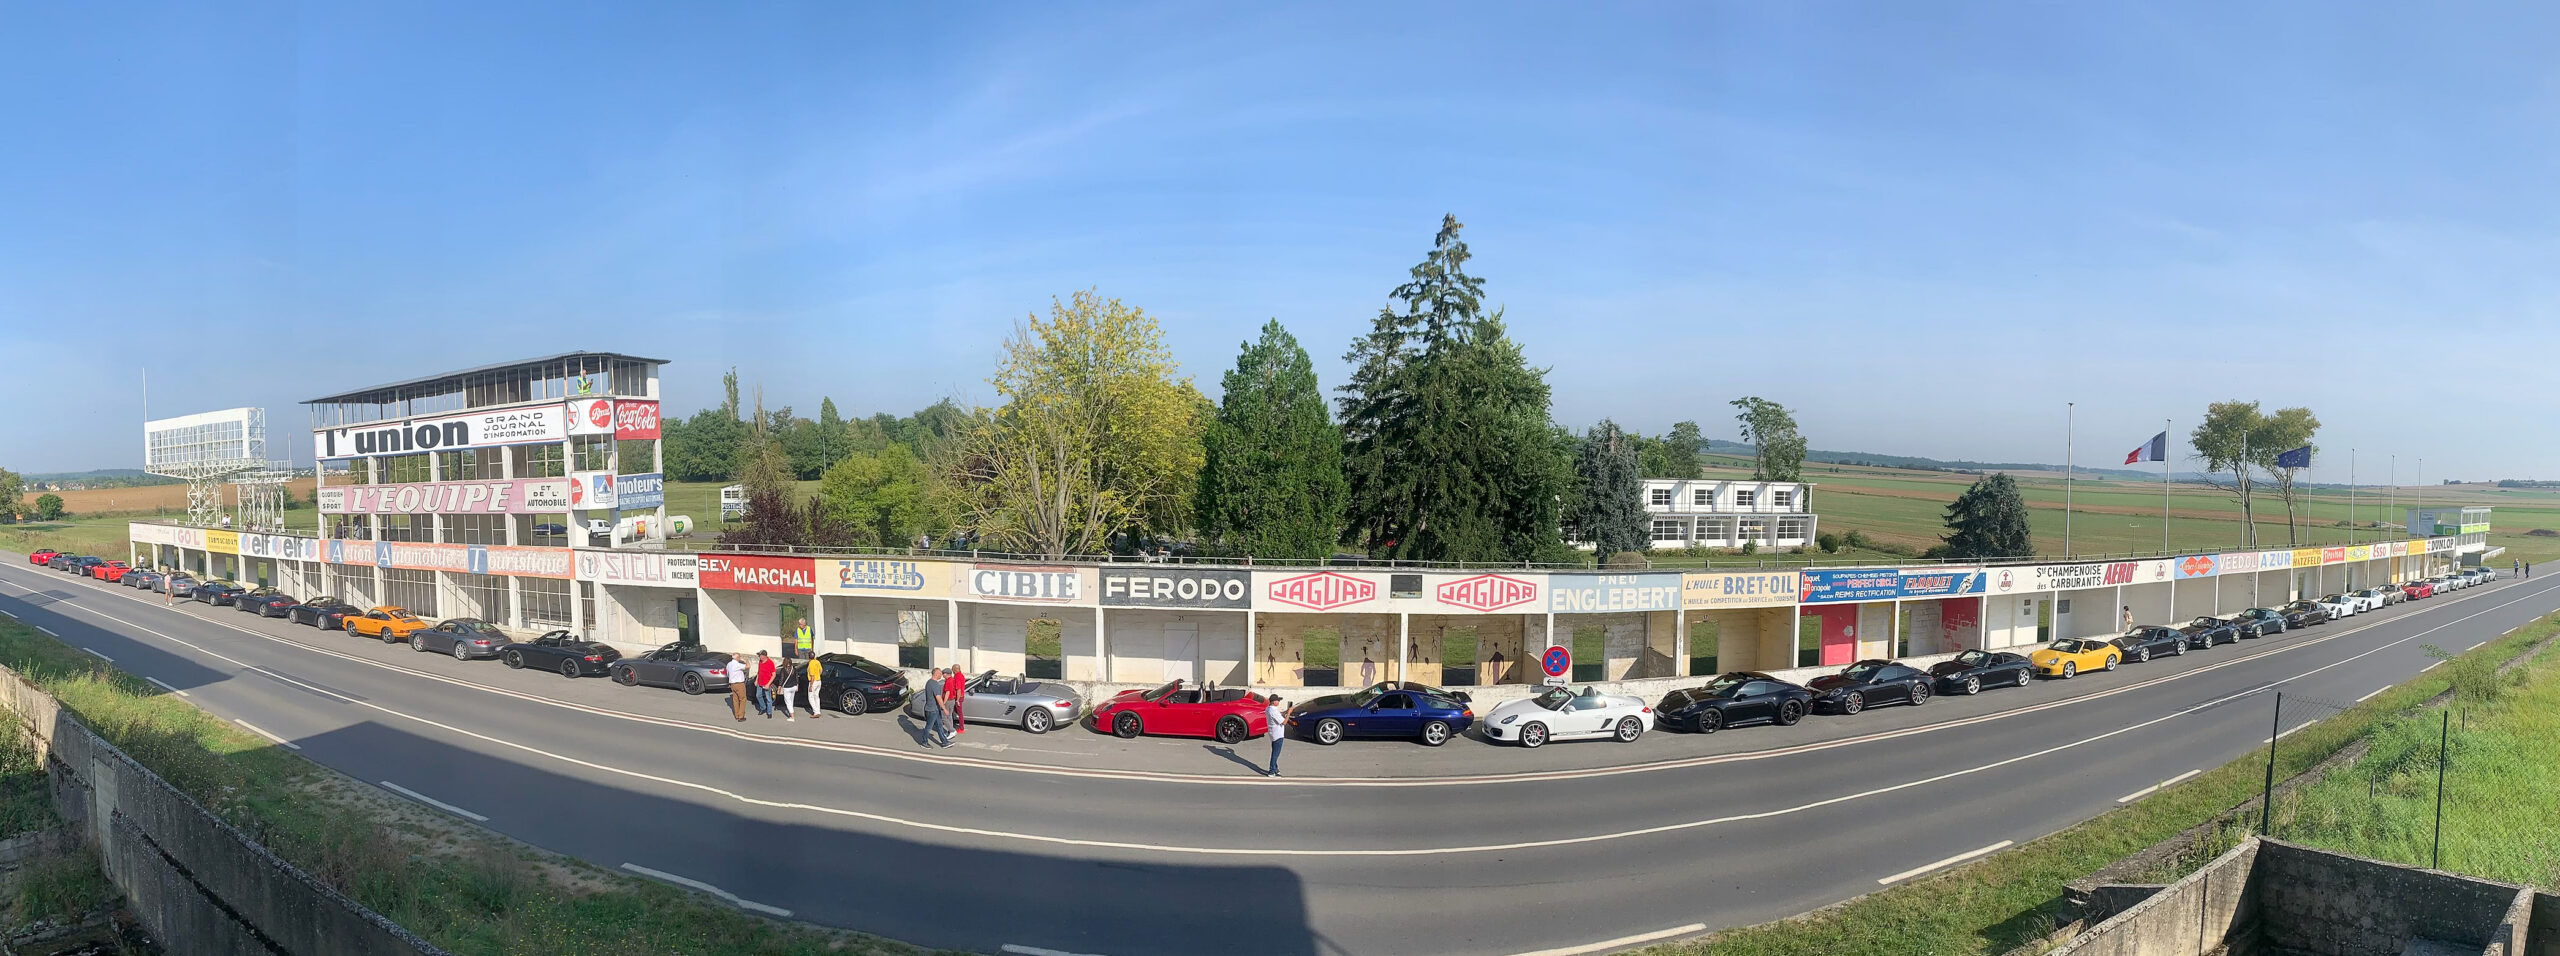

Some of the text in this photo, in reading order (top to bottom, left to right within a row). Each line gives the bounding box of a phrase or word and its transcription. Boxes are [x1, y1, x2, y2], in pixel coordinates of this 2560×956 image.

[485, 412, 544, 424] GRAND
[616, 403, 657, 431] Coca-Cola
[484, 421, 546, 431] JOURNAL
[484, 429, 546, 439] D'INFORMATION
[617, 478, 663, 494] moteurs
[351, 483, 513, 513] L'EQUIPE
[527, 498, 567, 507] AUTOMOBILE
[676, 522, 683, 530] BP
[251, 534, 271, 555] elf
[283, 537, 303, 558] elf
[2431, 538, 2454, 551] DUNLOP
[667, 558, 697, 567] PROTECTION
[700, 558, 731, 572] S.E.V.
[2219, 553, 2256, 570] VEEDOL
[2260, 552, 2291, 568] AZUR
[2292, 556, 2321, 566] HATZFELD
[671, 571, 694, 580] INCENDIE
[733, 567, 815, 589] MARCHAL
[839, 561, 920, 588] ZENITH
[1599, 575, 1637, 585] PNEU
[2047, 565, 2102, 578] CHAMPENOISE
[2102, 562, 2134, 585] AERO
[974, 570, 1076, 598] CIBIE
[1105, 577, 1245, 600] FERODO
[1273, 574, 1371, 606] JAGUAR
[1685, 575, 1795, 595] L'HUILE BRET-OIL
[1847, 578, 1875, 588] PERFECT
[1875, 577, 1898, 587] CIRCLE
[1904, 576, 1953, 589] FLOQUET
[2037, 577, 2101, 590] des CARBURANTS
[1441, 577, 1534, 607] JAGUAR
[1552, 586, 1678, 611] ENGLEBERT
[1856, 589, 1896, 598] RECTIFICATION
